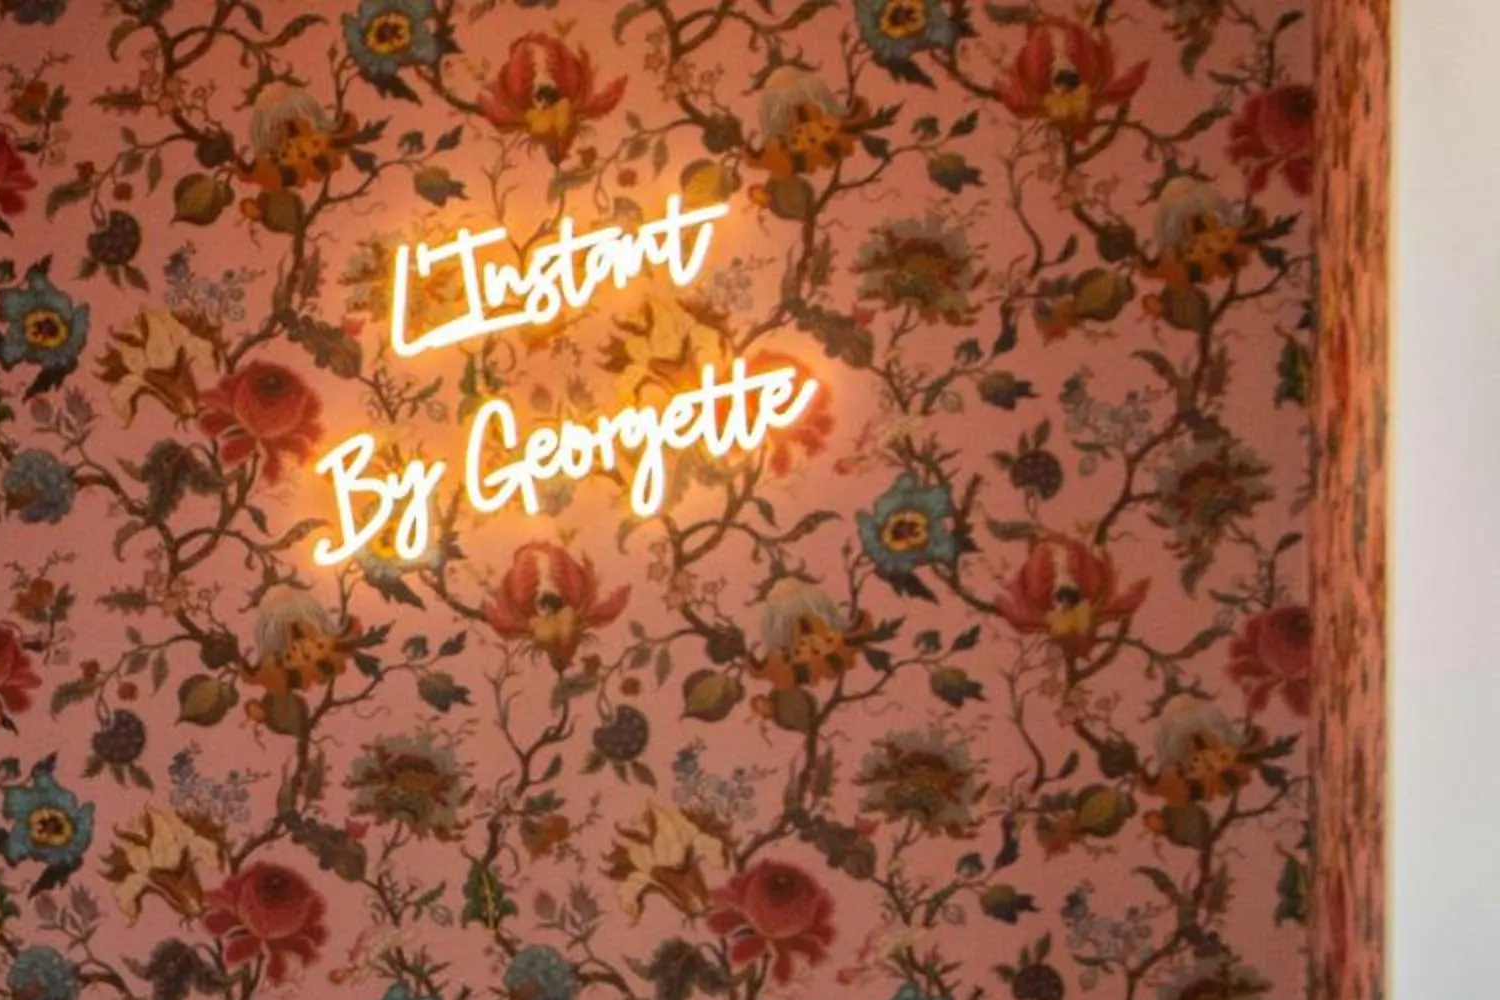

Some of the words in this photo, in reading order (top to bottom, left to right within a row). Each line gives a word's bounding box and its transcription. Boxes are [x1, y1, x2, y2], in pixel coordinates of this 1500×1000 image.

[392, 195, 728, 354] L'Instant
[313, 433, 445, 566] By
[466, 359, 818, 515] Georgette
